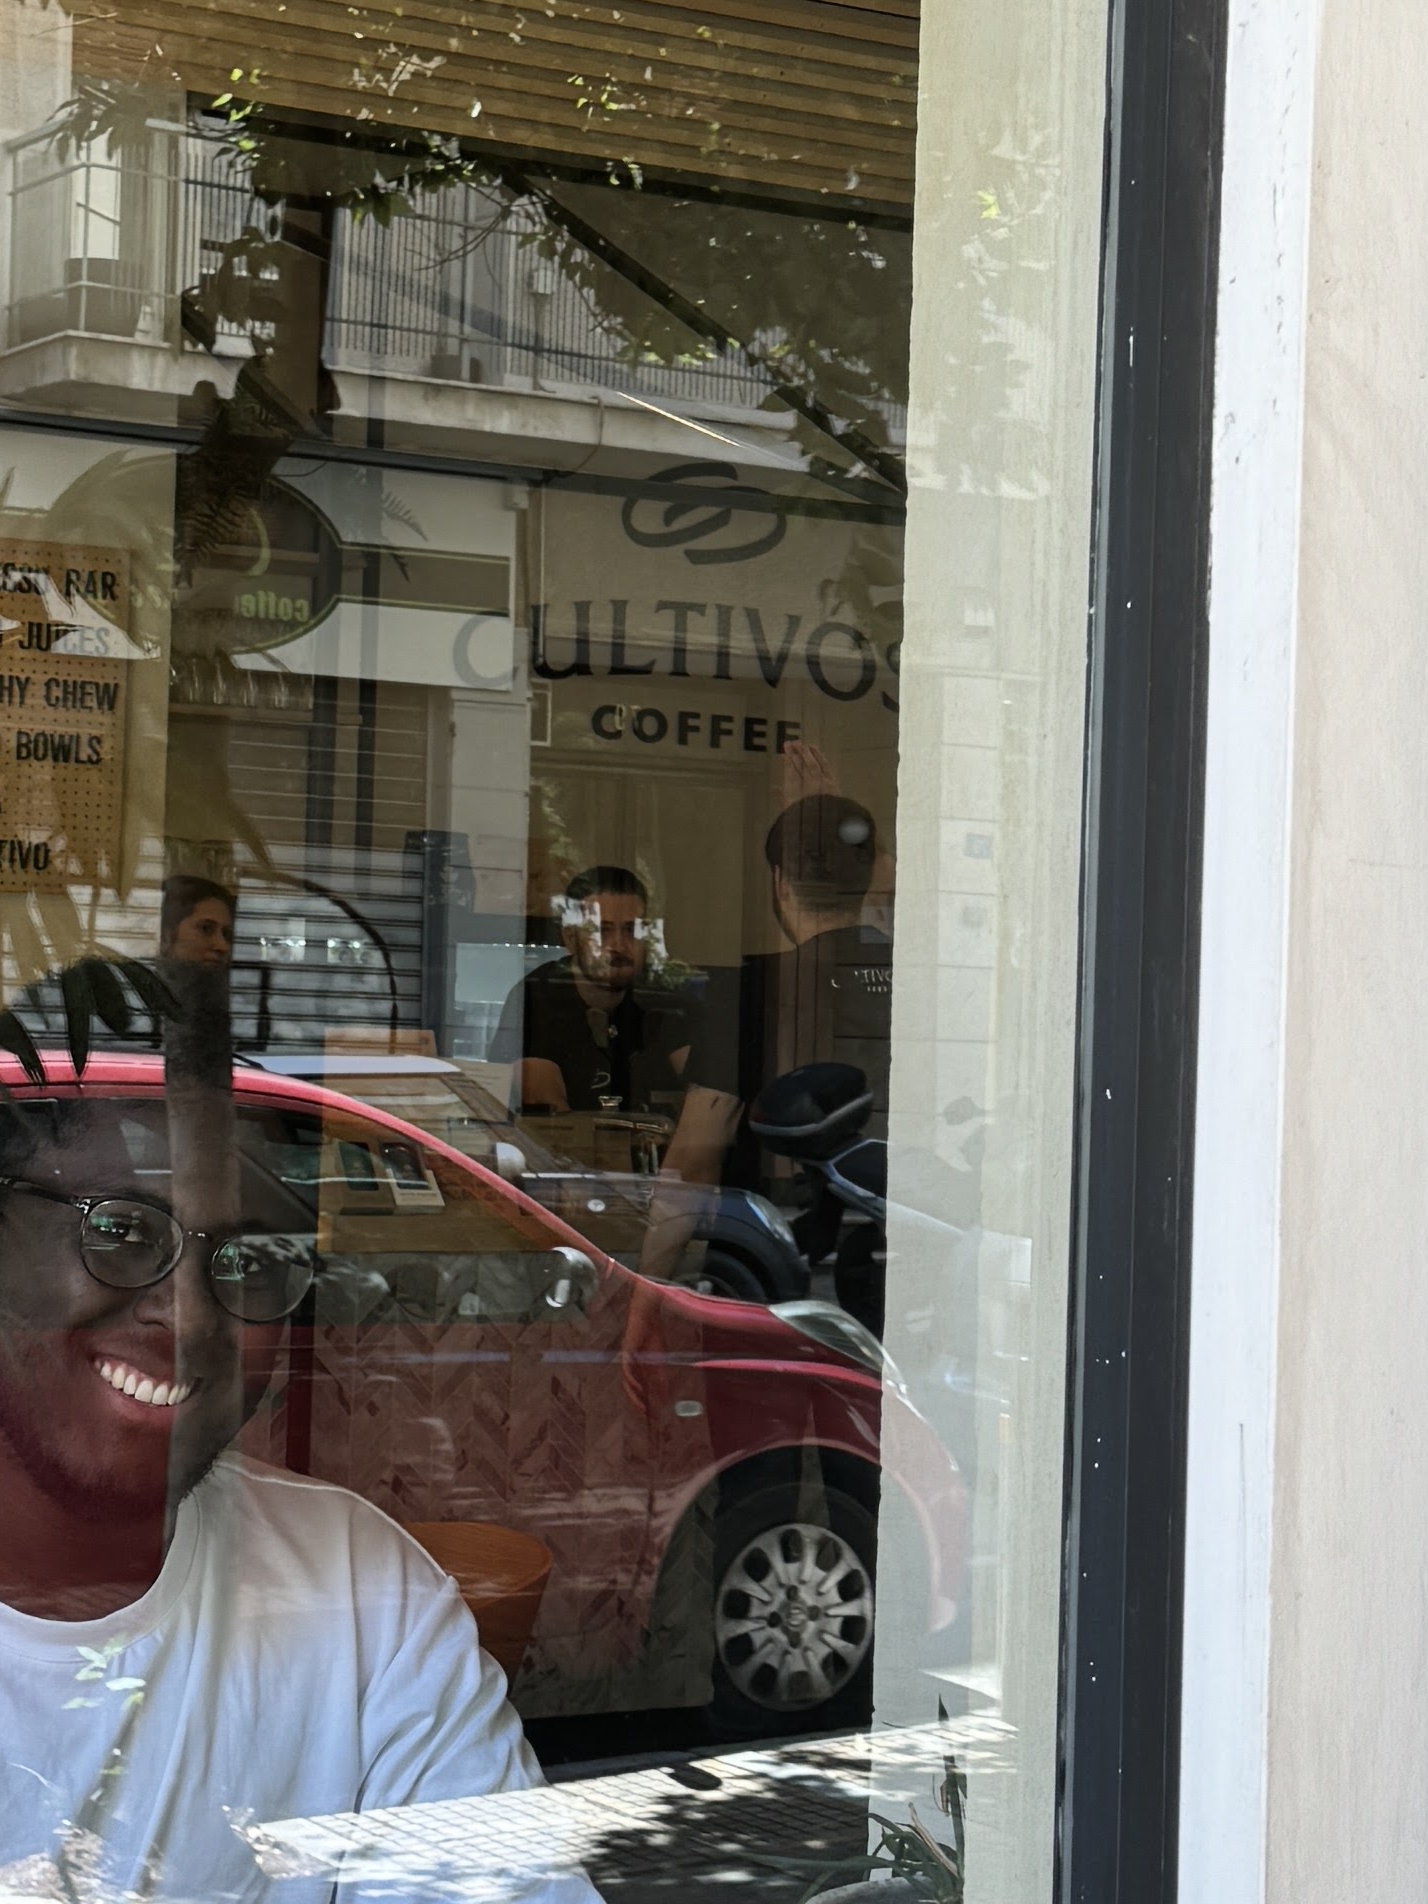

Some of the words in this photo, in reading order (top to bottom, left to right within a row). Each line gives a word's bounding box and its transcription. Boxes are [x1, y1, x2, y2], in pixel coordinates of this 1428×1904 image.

[65, 569, 118, 601] BAR
[43, 677, 121, 714] CHEW
[15, 730, 103, 765] BOWLS
